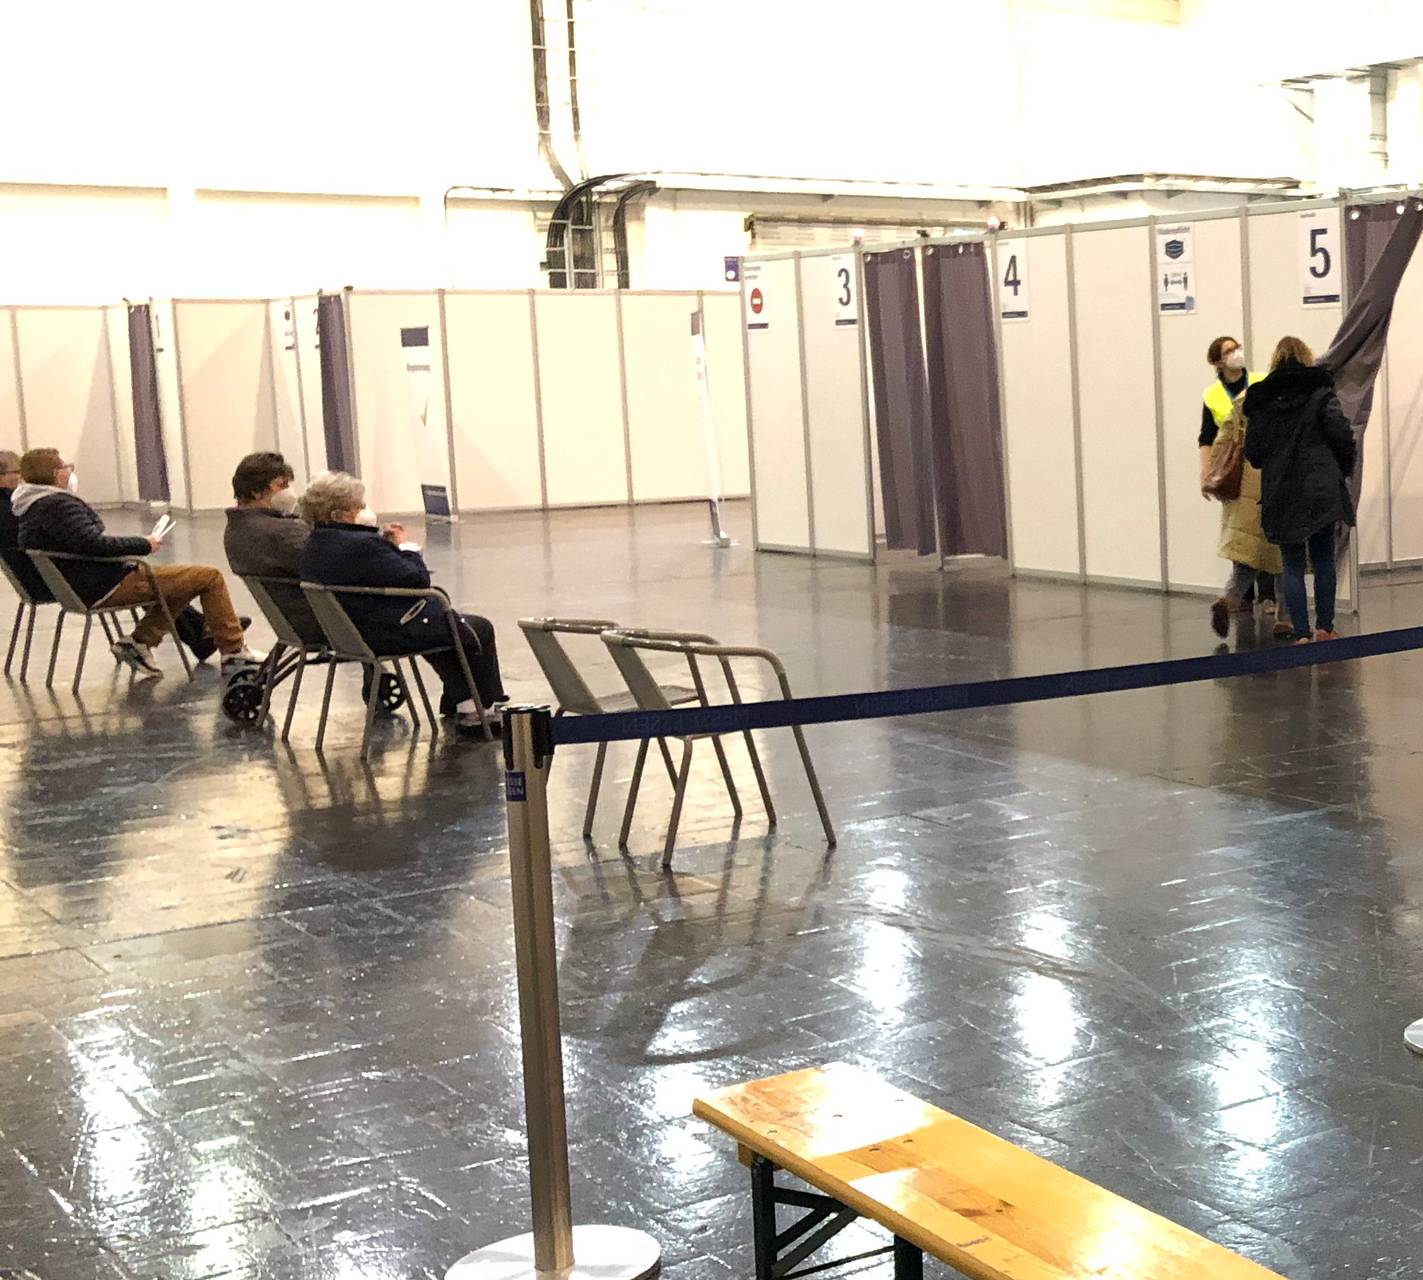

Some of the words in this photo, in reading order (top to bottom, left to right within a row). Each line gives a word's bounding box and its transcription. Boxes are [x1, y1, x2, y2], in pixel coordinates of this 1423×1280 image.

[1309, 228, 1331, 279] 5
[837, 267, 851, 307] 3
[1004, 255, 1021, 296] 4
